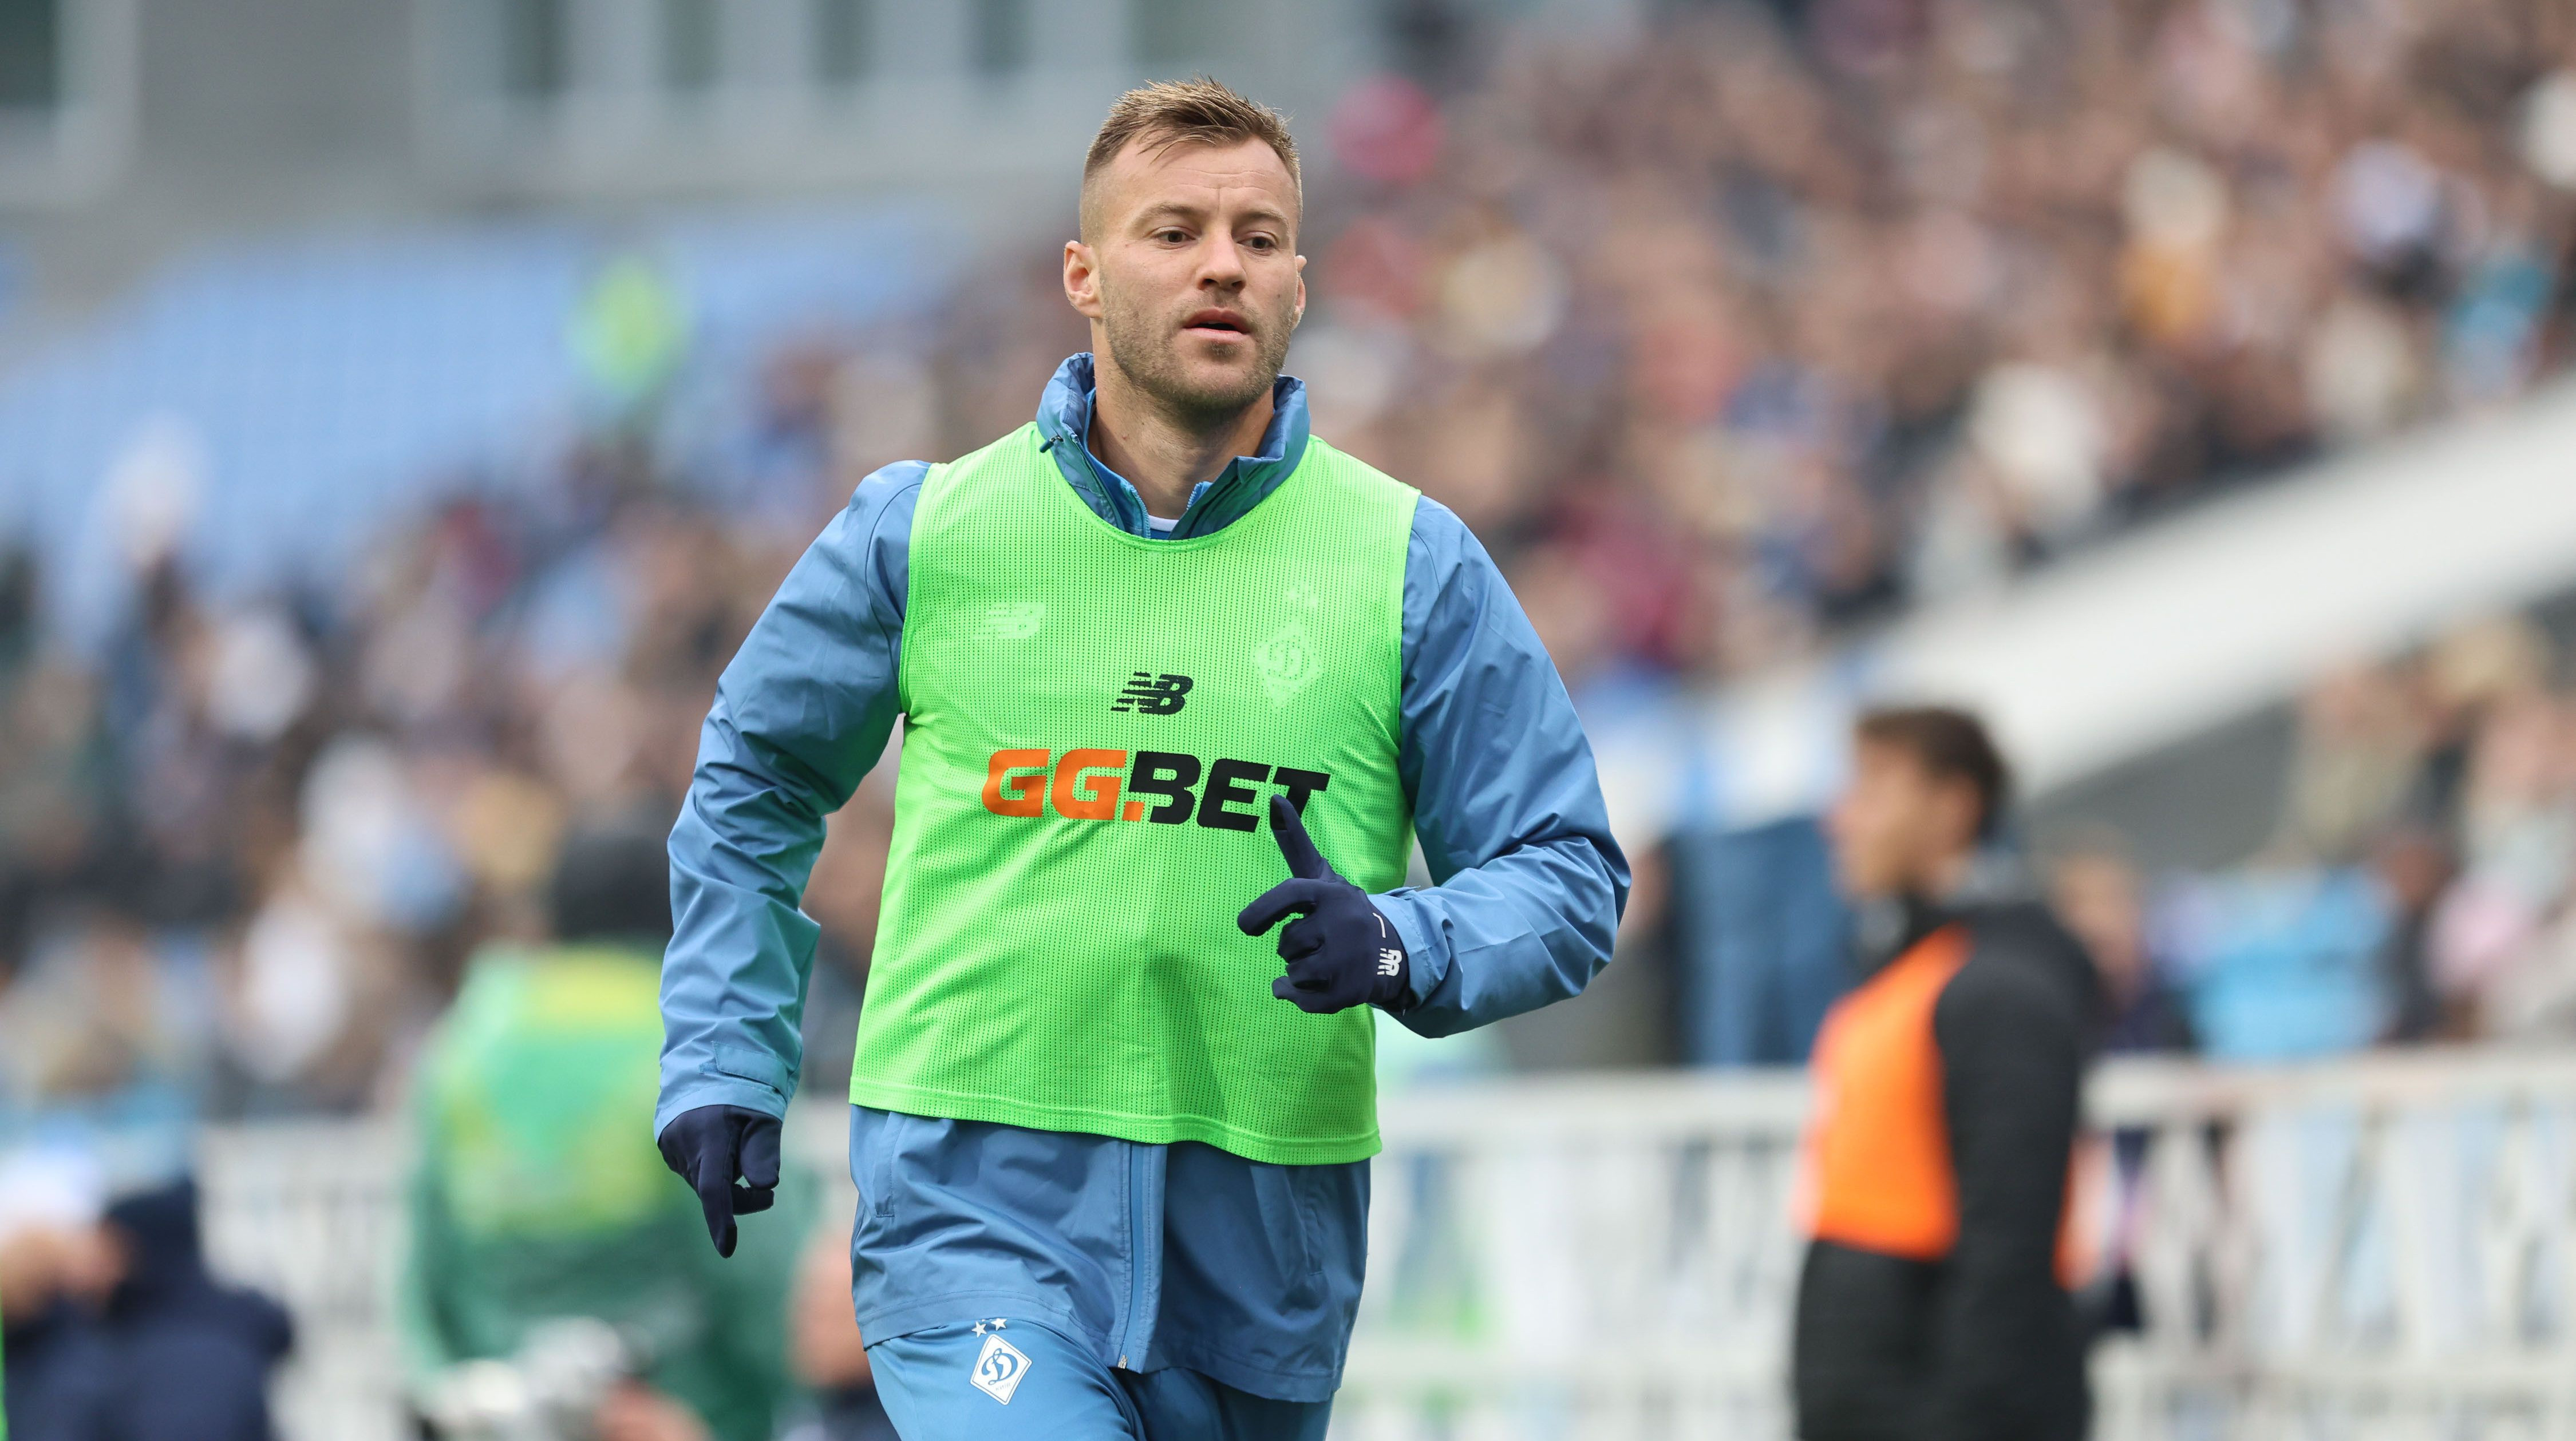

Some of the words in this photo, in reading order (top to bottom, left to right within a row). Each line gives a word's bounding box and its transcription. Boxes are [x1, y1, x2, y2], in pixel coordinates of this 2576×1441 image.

[1111, 671, 1194, 715] NB
[981, 749, 1331, 833] GG.BET
[1377, 948, 1402, 976] NB
